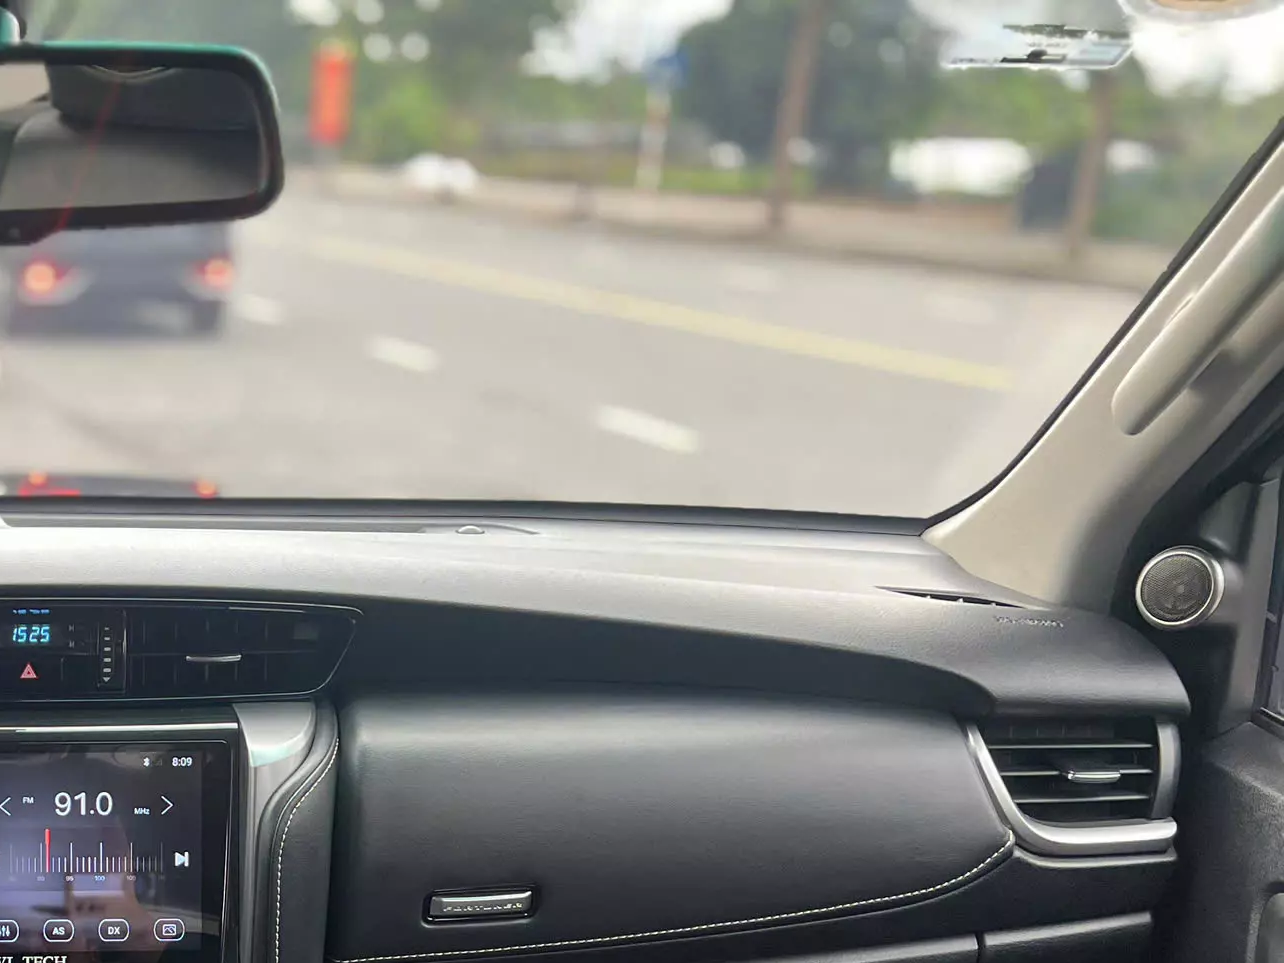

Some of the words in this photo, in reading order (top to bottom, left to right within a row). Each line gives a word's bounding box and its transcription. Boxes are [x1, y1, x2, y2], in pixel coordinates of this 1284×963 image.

[172, 756, 192, 766] 8:09
[54, 791, 114, 816] 91.0
[52, 926, 66, 936] AS
[108, 926, 120, 936] DX
